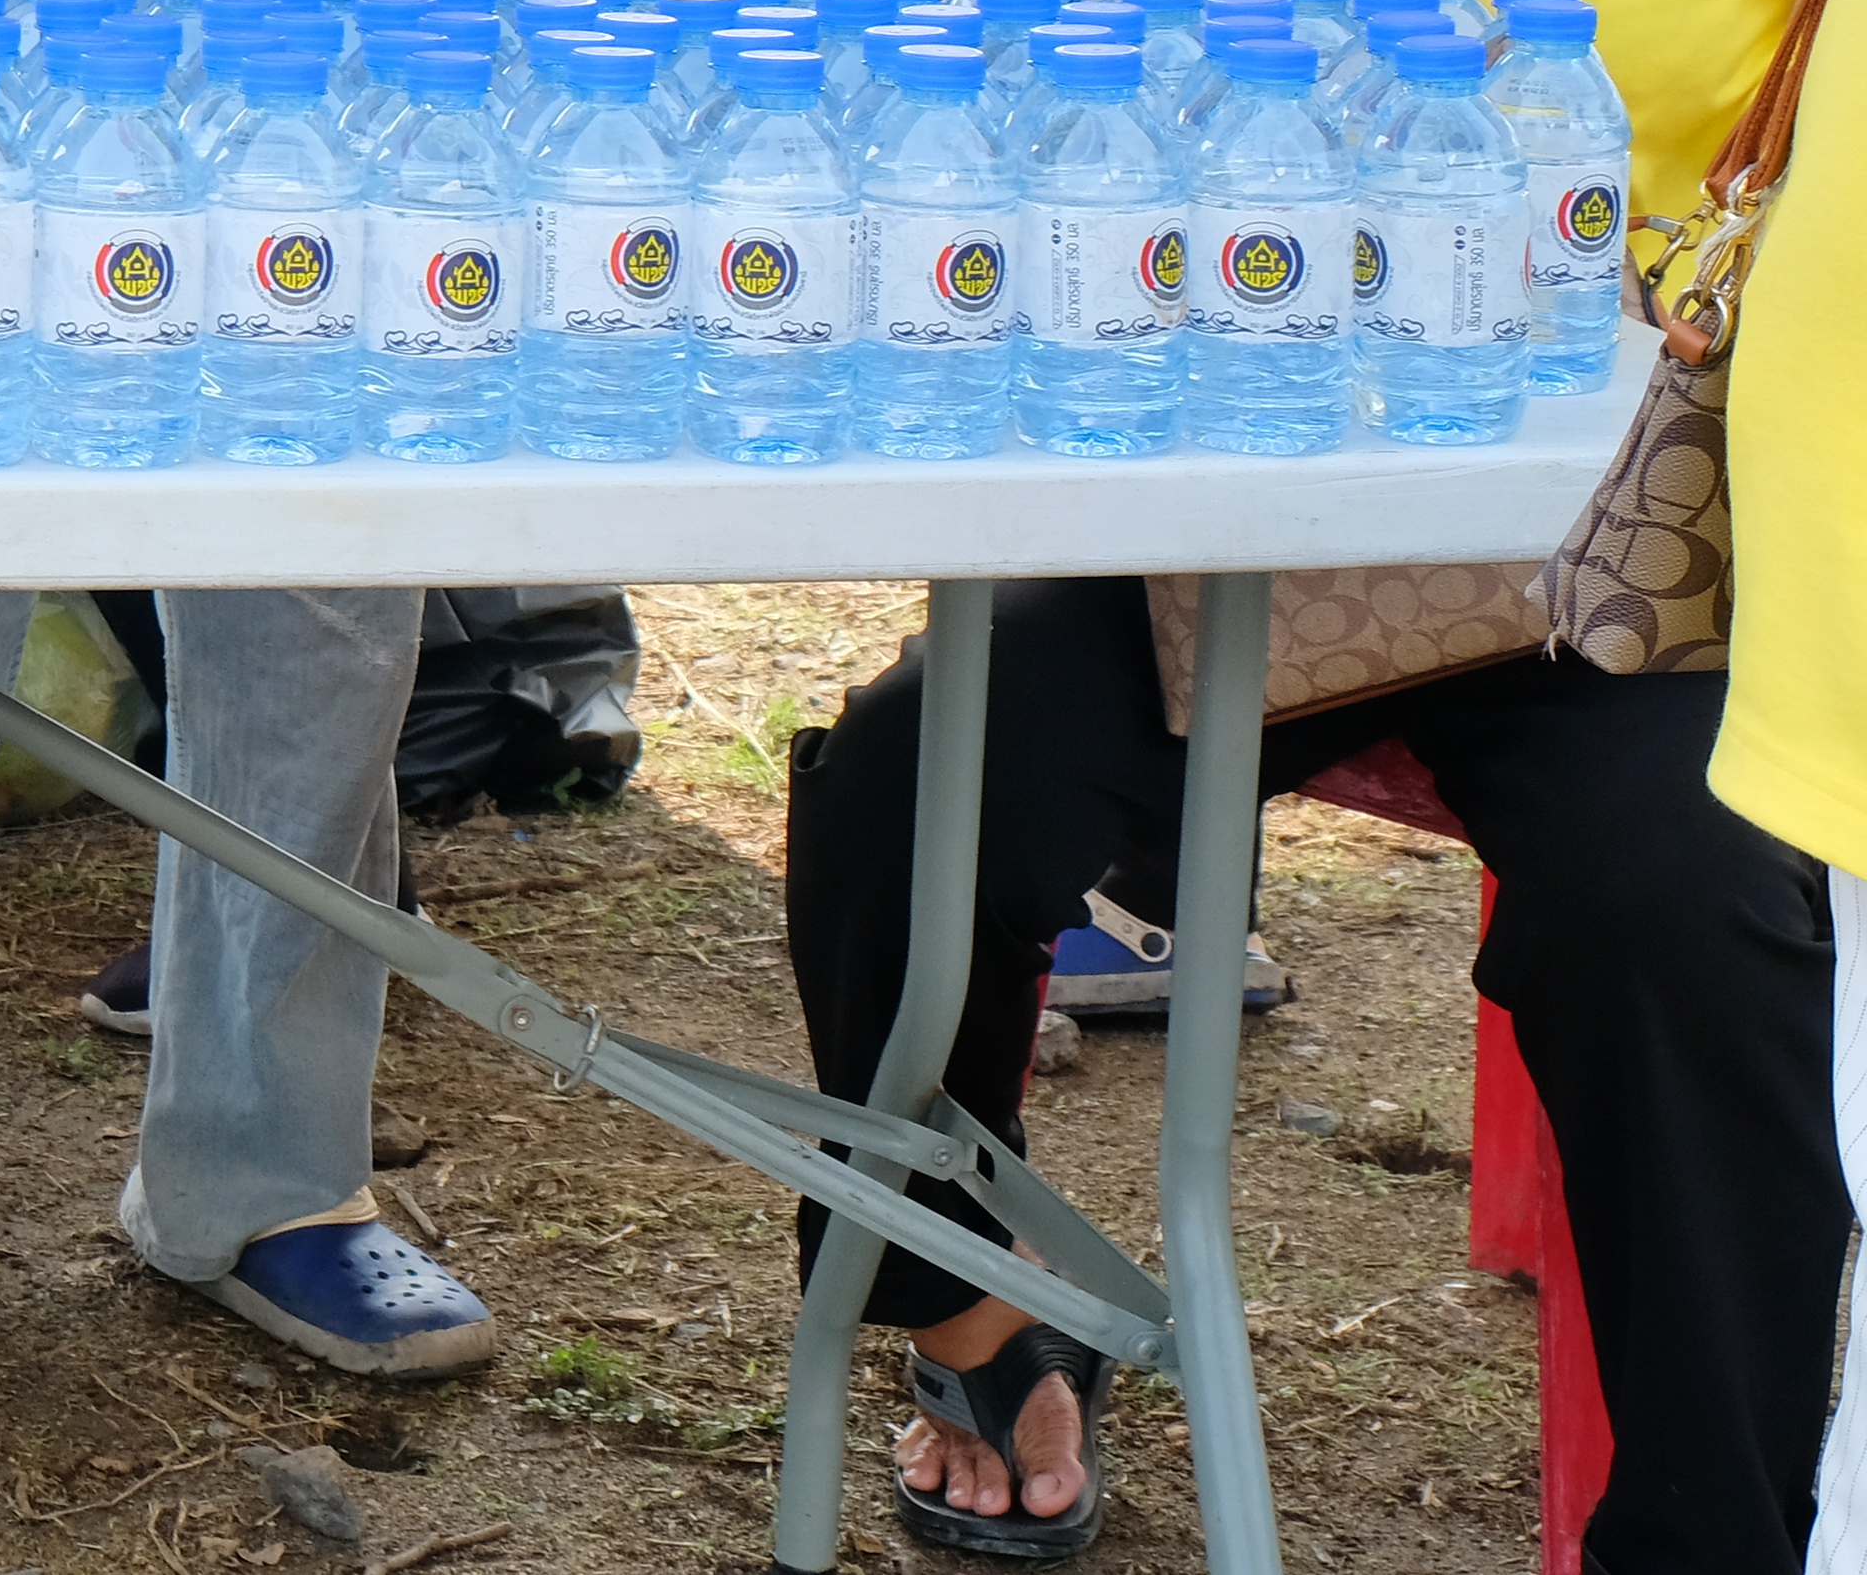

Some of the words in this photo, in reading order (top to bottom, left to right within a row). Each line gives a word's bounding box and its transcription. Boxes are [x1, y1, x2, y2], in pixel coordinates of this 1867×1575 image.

[545, 229, 557, 250] 350
[869, 240, 882, 260] 350
[1066, 242, 1080, 262] 350
[1470, 247, 1484, 267] 350
